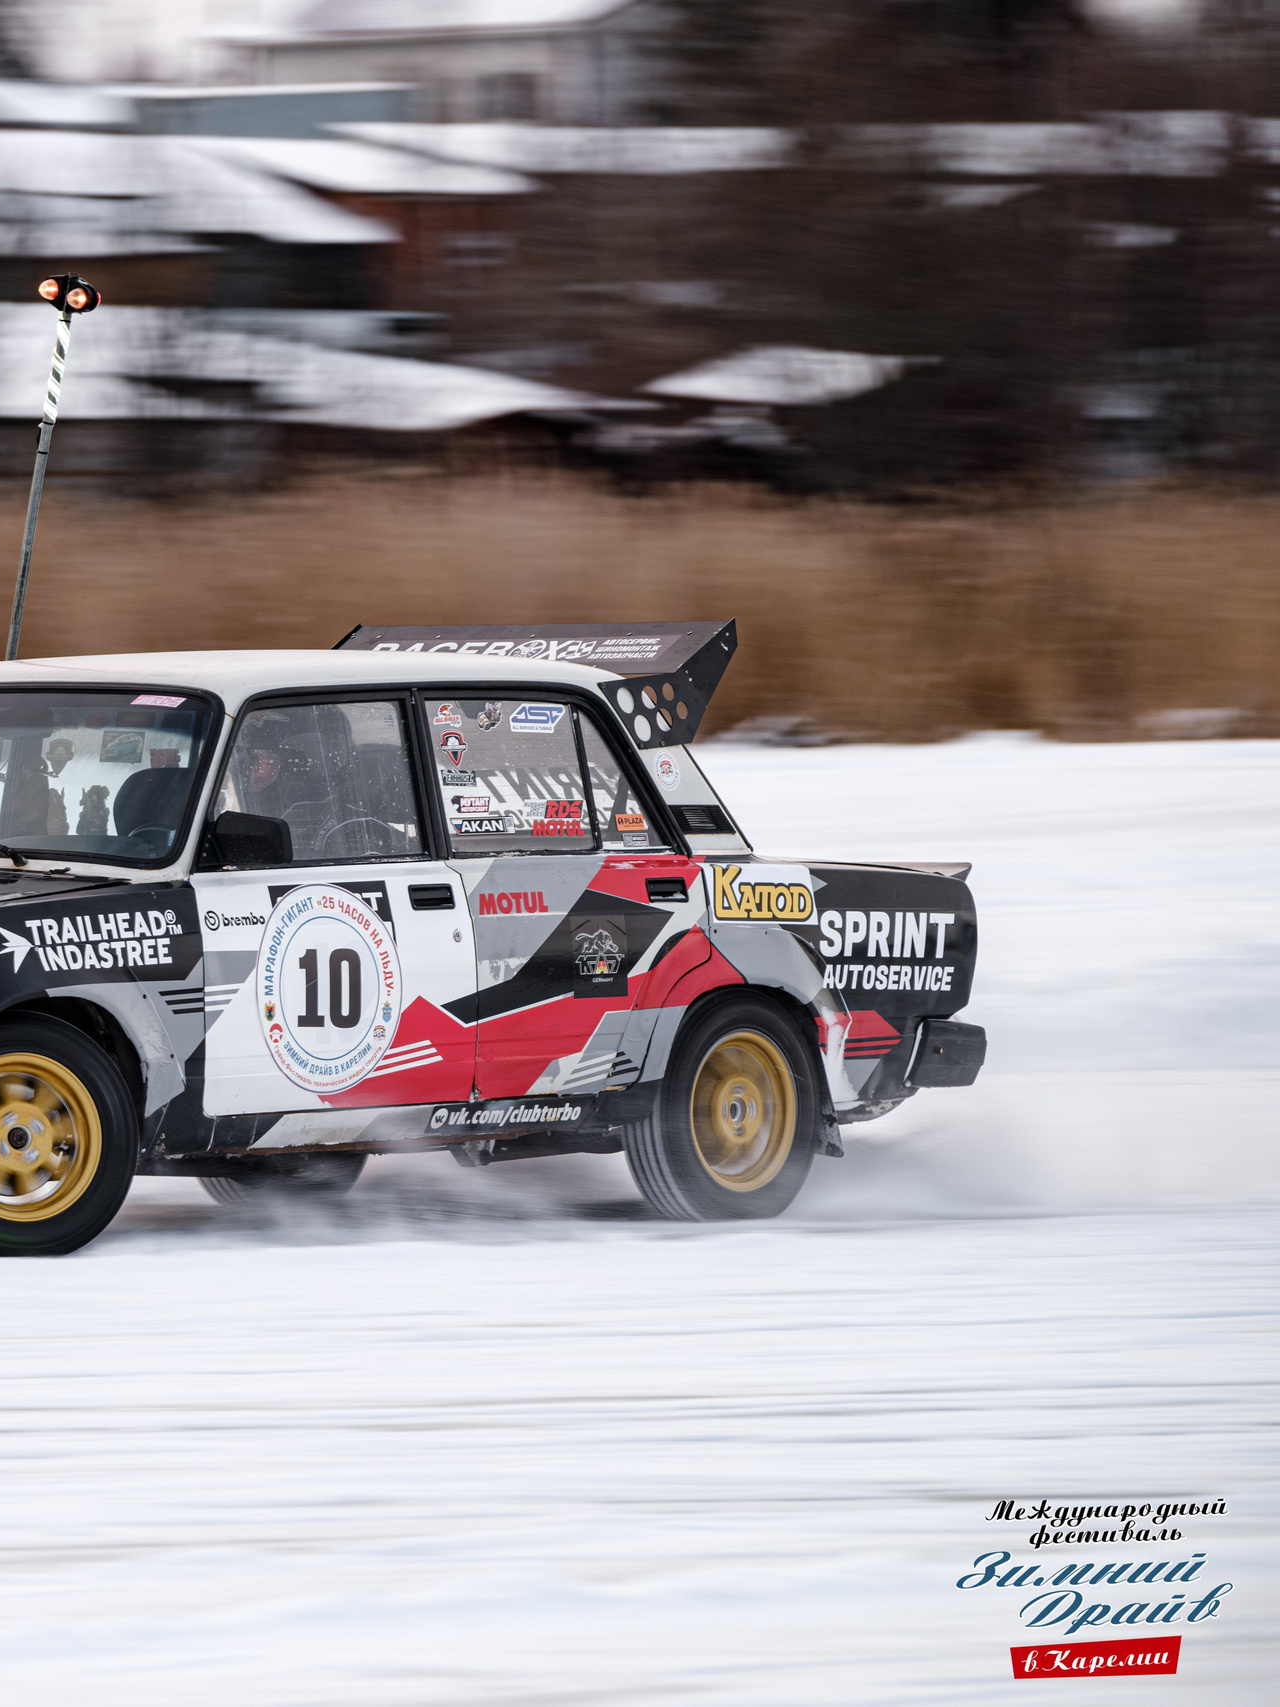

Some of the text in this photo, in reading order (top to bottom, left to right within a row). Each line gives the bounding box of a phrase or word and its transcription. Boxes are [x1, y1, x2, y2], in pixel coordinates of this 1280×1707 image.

[460, 797, 489, 806] МУТАНТ
[546, 801, 582, 818] RDS
[461, 820, 504, 832] AKAN
[532, 820, 585, 837] MOTUL
[479, 891, 548, 915] MOTUL
[222, 912, 265, 928] brembo
[820, 910, 955, 958] SPRINT
[37, 938, 173, 971] INDASTREE
[265, 897, 314, 996] МАРАФОН-ГИГАНТ
[338, 900, 371, 931] ЧАСОВ
[370, 929, 384, 949] НА
[297, 948, 361, 1028] 10
[823, 964, 954, 991] AUTOSERVICE
[284, 1041, 309, 1070] ЗИМНИЙ
[309, 1064, 333, 1076] ДРАЙВ
[340, 1042, 372, 1073] КАРЕЛИИ
[448, 1103, 581, 1127] vk.com/clubturbo
